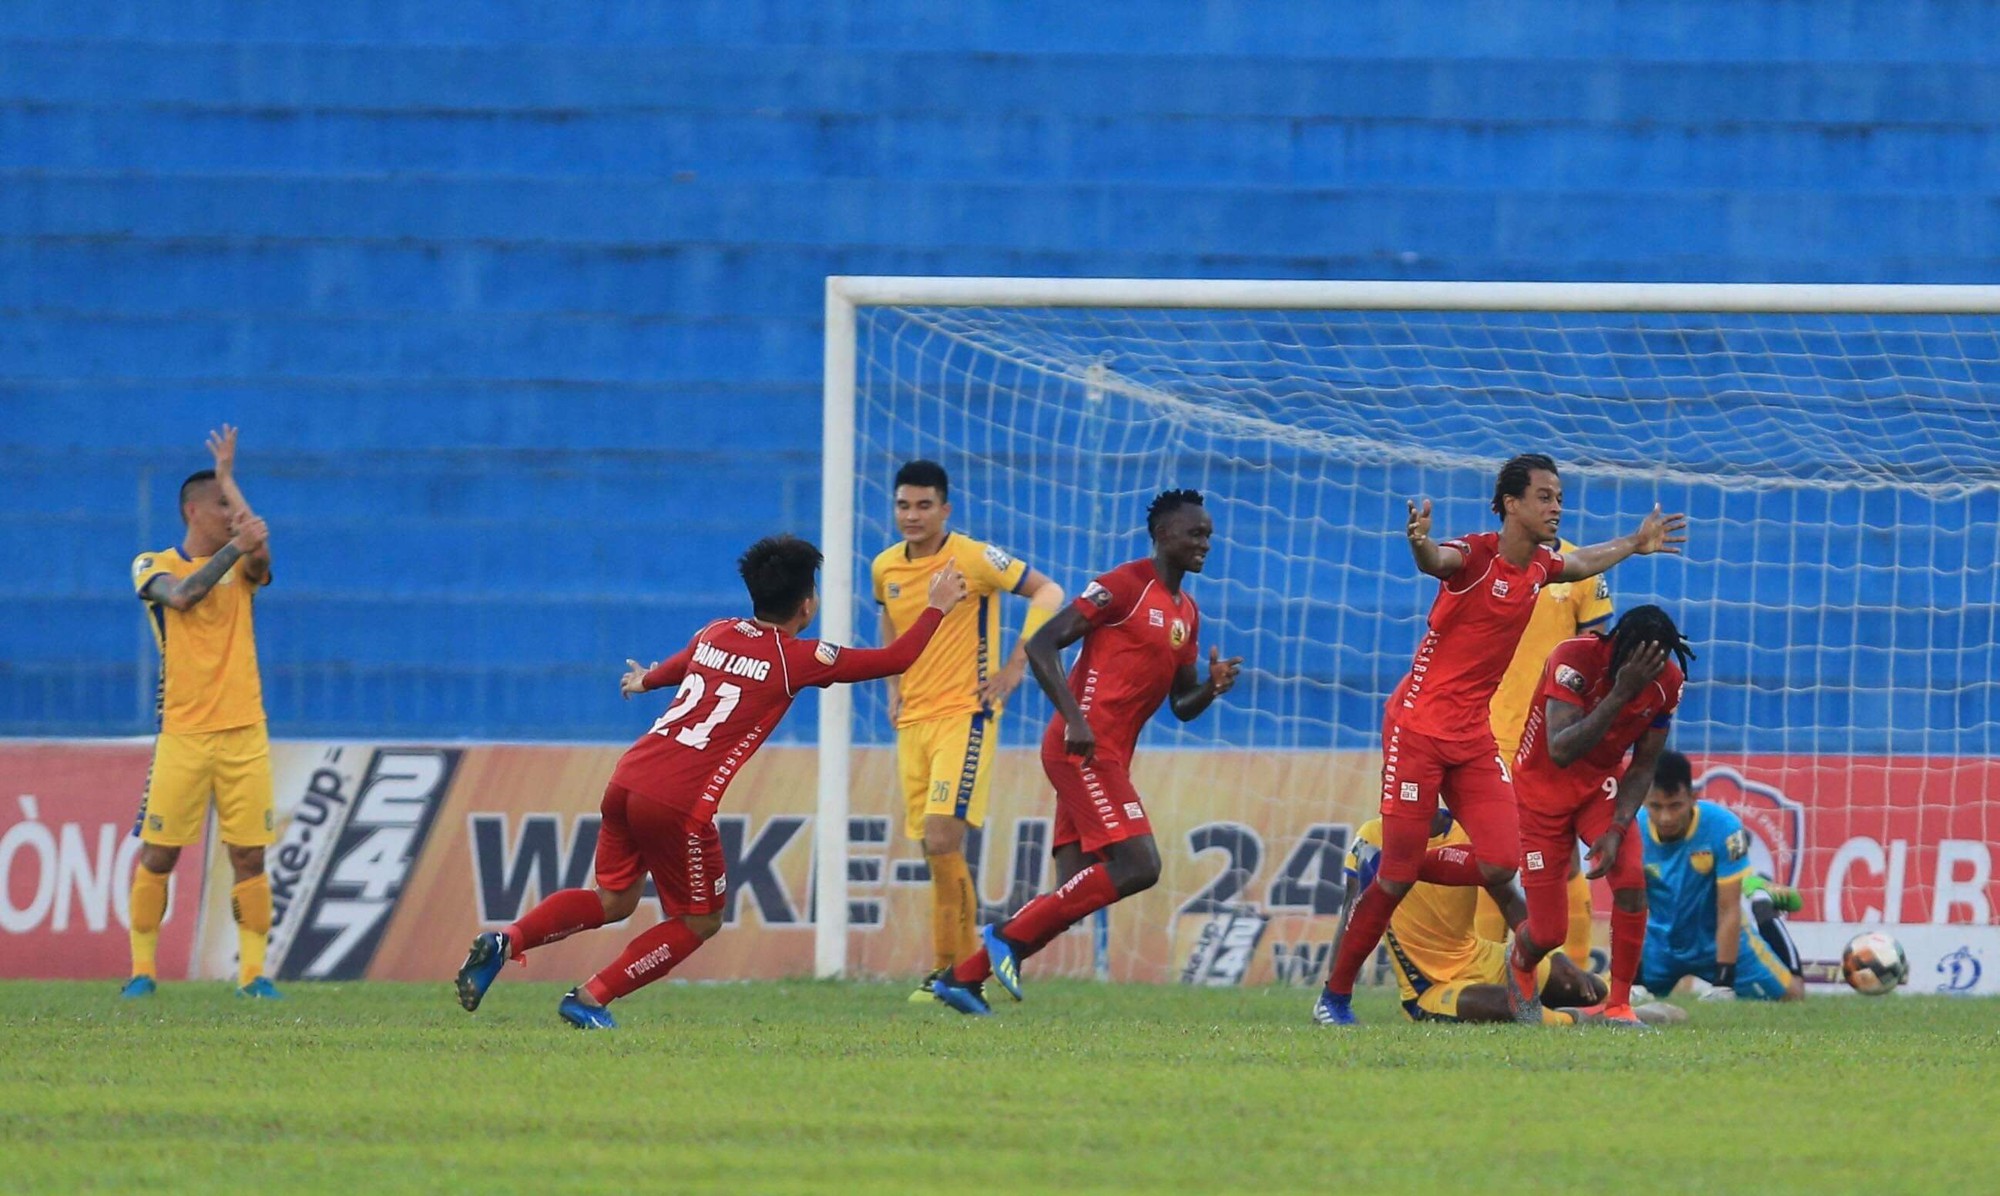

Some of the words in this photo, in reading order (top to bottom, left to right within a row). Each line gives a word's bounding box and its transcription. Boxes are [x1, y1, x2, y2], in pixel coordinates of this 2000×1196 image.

[724, 654, 771, 682] LONG
[648, 672, 742, 751] 21
[930, 780, 951, 802] 26
[1601, 776, 1619, 801] 9
